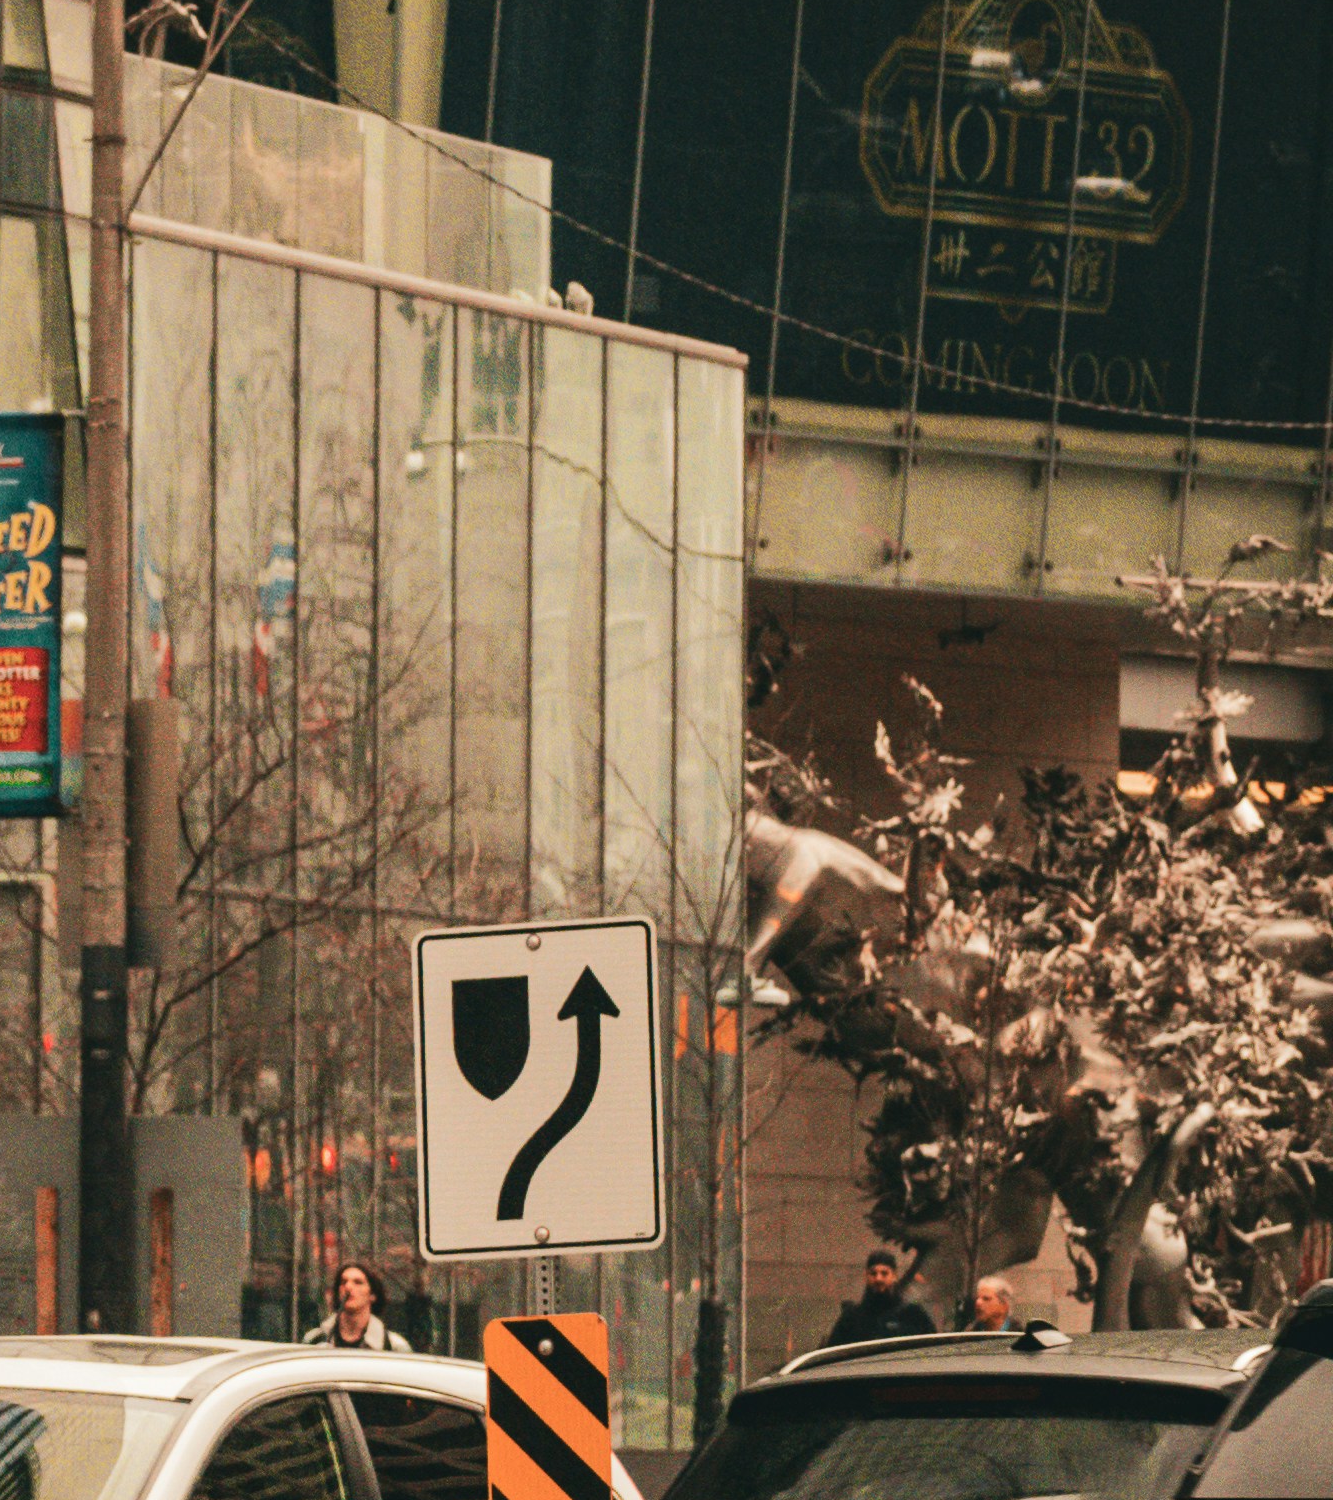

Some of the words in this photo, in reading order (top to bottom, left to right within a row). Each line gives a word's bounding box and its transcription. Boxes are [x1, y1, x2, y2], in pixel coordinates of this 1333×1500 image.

[893, 99, 1068, 193] MOTT
[841, 329, 1036, 396] COMING
[1047, 352, 1171, 416] SOON
